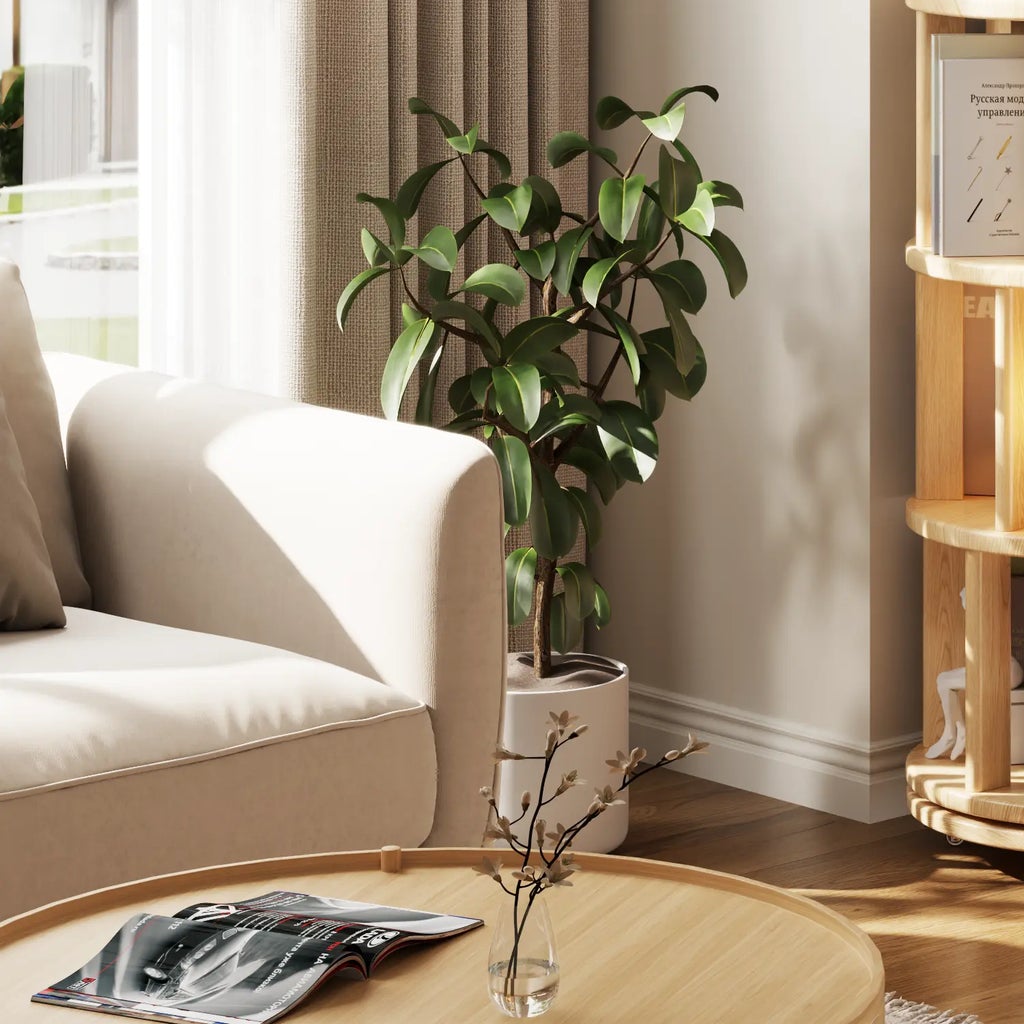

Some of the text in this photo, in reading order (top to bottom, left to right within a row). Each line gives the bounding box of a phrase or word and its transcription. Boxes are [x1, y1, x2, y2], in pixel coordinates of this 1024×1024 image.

[970, 93, 1005, 106] Русская
[350, 927, 387, 945] LADA
[313, 952, 330, 965] НА
